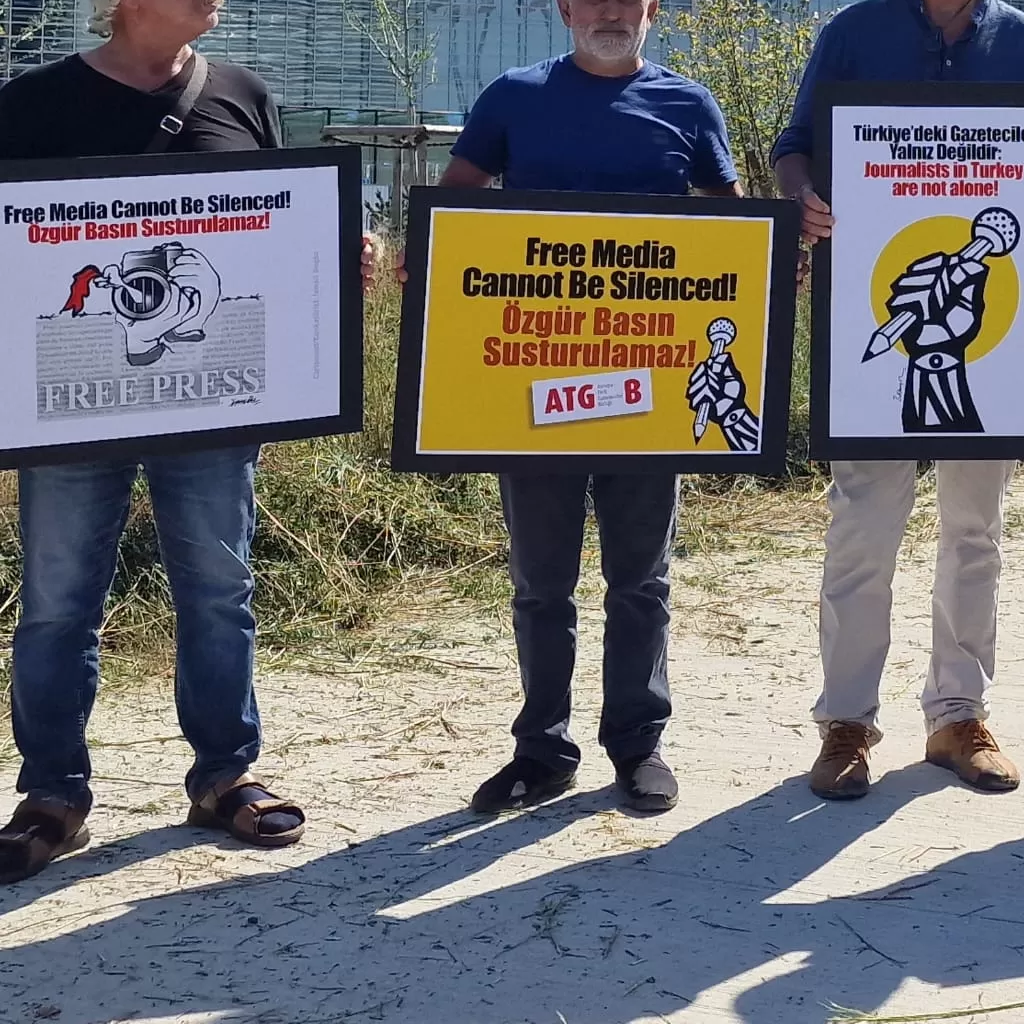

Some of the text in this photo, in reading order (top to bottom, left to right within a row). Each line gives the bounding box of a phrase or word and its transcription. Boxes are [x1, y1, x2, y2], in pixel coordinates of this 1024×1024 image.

[854, 125, 948, 144] Türkiye'deki
[889, 143, 1002, 162] Yalnız Değildir:
[864, 161, 1024, 180] Journalists in Turkey
[892, 180, 999, 197] are not alone!
[4, 190, 291, 224] Free Media Cannot Be Silenced!
[28, 212, 270, 245] Özgür Basın Susturulamaz!
[526, 237, 676, 269] Free Media
[462, 266, 738, 301] Cannot Be Silenced!
[502, 300, 675, 339] Özgür Basın
[483, 337, 697, 368] Susturulamaz!
[43, 367, 260, 413] FREE PRESS
[545, 384, 596, 414] ATG
[624, 378, 642, 405] B
